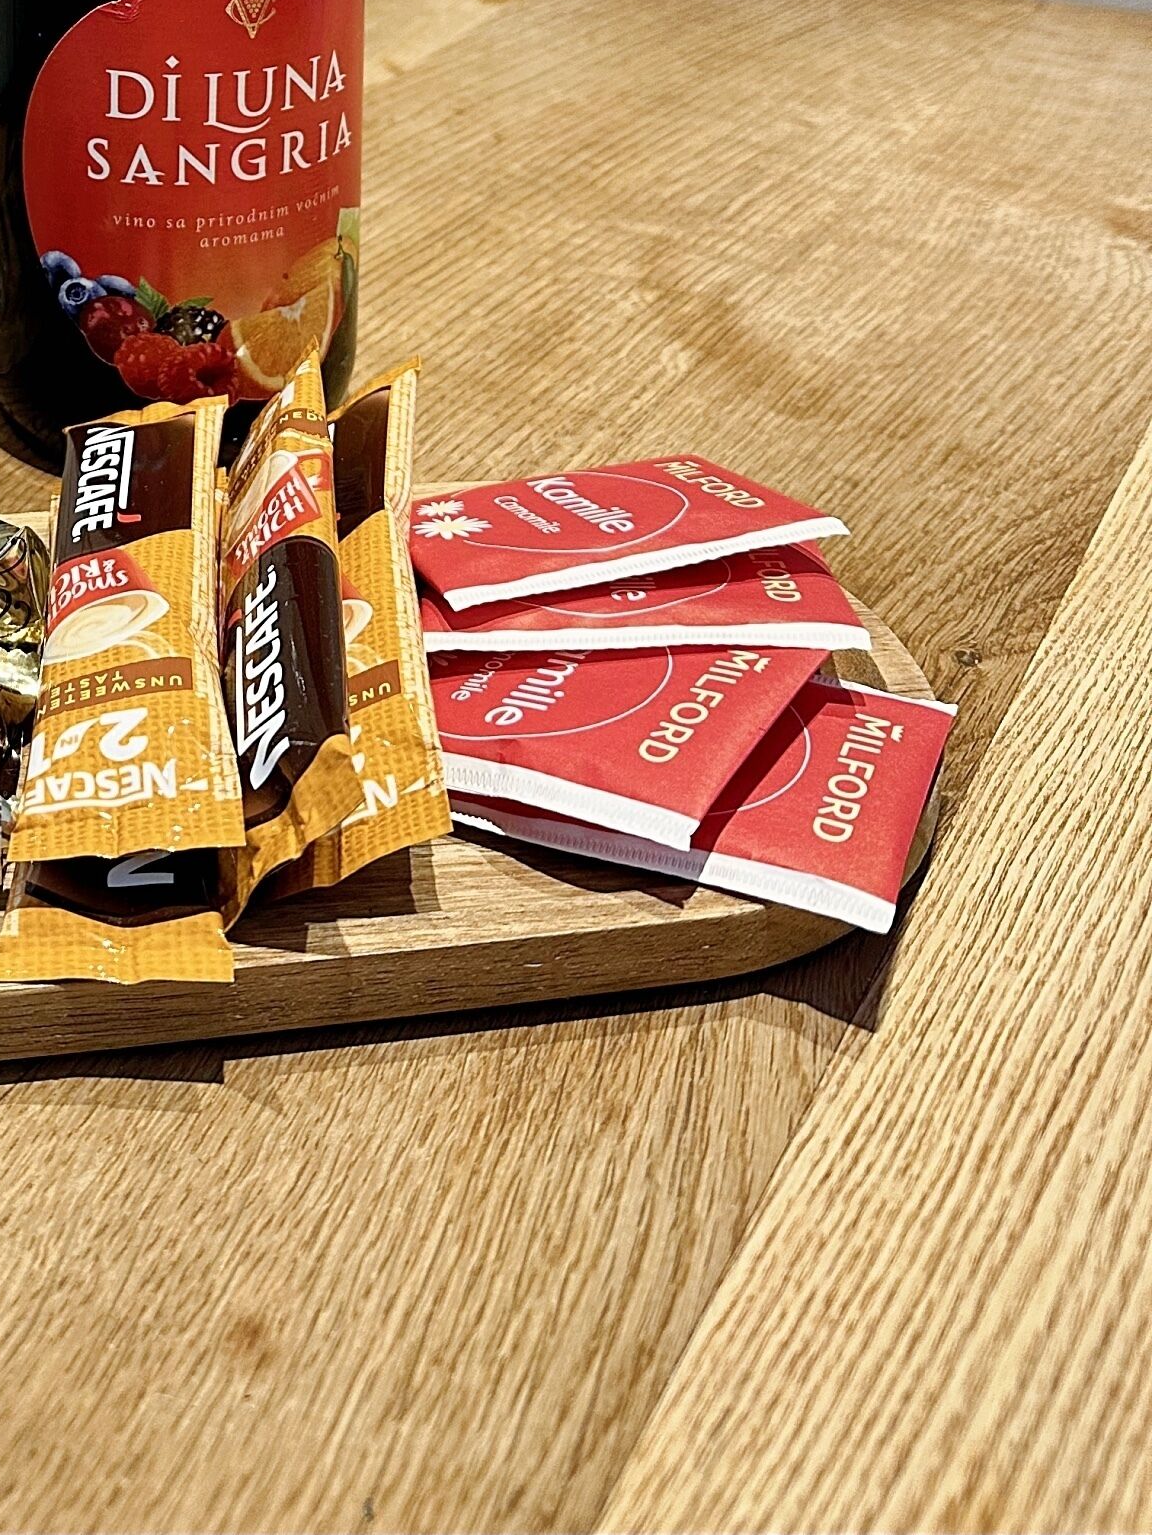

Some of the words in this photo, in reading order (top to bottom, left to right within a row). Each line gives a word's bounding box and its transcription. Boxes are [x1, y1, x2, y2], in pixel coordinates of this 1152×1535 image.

[203, 49, 347, 134] LUNA
[87, 112, 352, 186] SANGRIA
[113, 212, 156, 228] vino
[165, 216, 186, 229] sa
[196, 204, 289, 233] prirodnim
[199, 225, 285, 248] aromama
[527, 476, 636, 534] Kamille
[654, 460, 766, 509] MILFORD
[493, 495, 562, 535] Camomile
[37, 675, 184, 715] UNSWEETEN
[50, 670, 124, 694] TASTE
[638, 650, 759, 763] MILFORD
[22, 757, 177, 816] NESCAF
[813, 713, 892, 843] MILFORD
